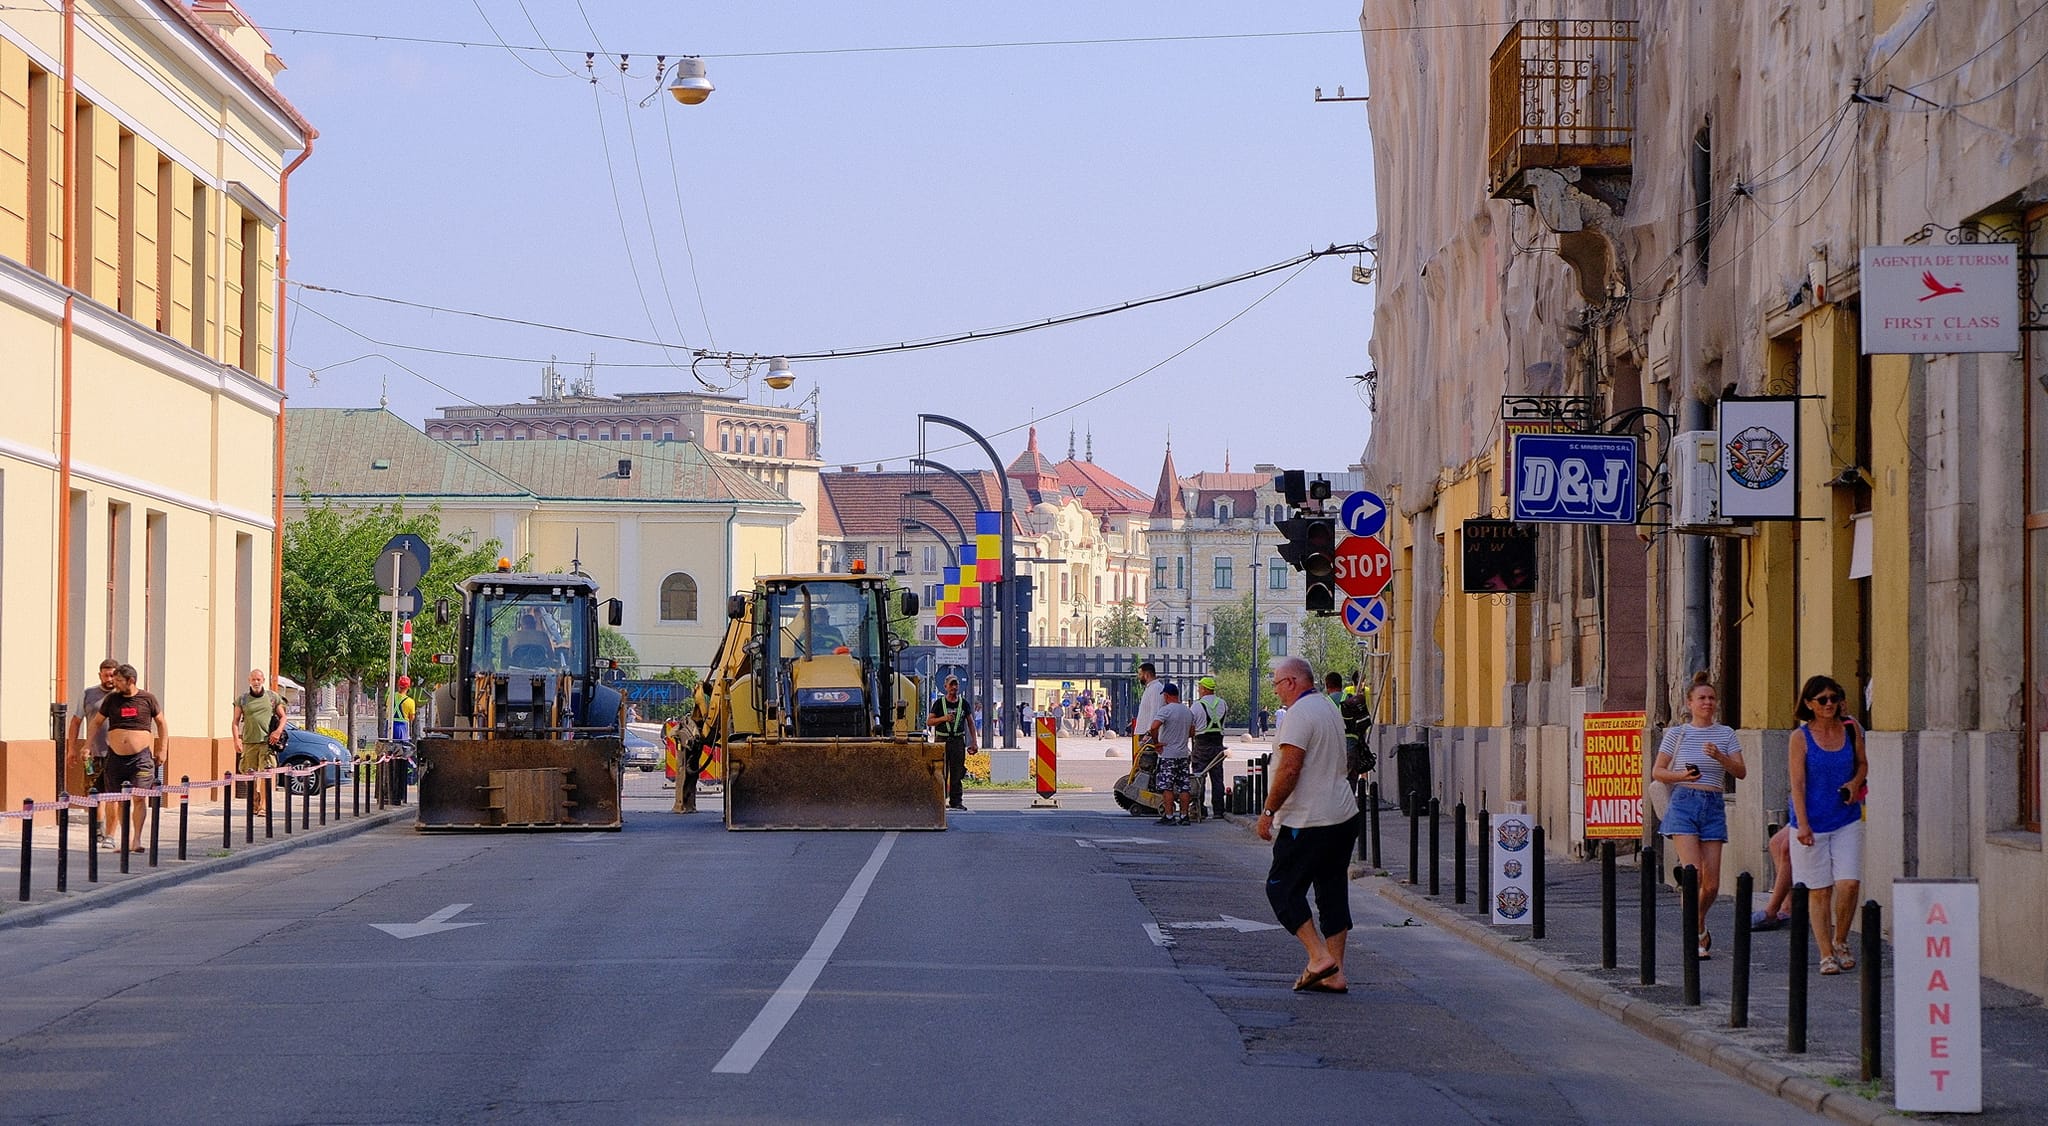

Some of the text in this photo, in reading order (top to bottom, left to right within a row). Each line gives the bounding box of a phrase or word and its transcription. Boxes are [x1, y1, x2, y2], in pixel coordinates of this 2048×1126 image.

[1936, 256, 1955, 266] DE
[1957, 255, 2009, 266] TURISM
[1884, 316, 2000, 329] FIRST CLASS
[1912, 332, 1974, 342] TRAVEL
[1520, 457, 1628, 509] D&J
[1747, 481, 1759, 489] DE
[1466, 525, 1529, 538] OPTICA
[1334, 553, 1388, 579] STOP
[814, 691, 841, 701] CAT
[1613, 720, 1620, 728] LA
[1587, 735, 1629, 753] BIROUL
[1926, 903, 1951, 1091] AMANET
